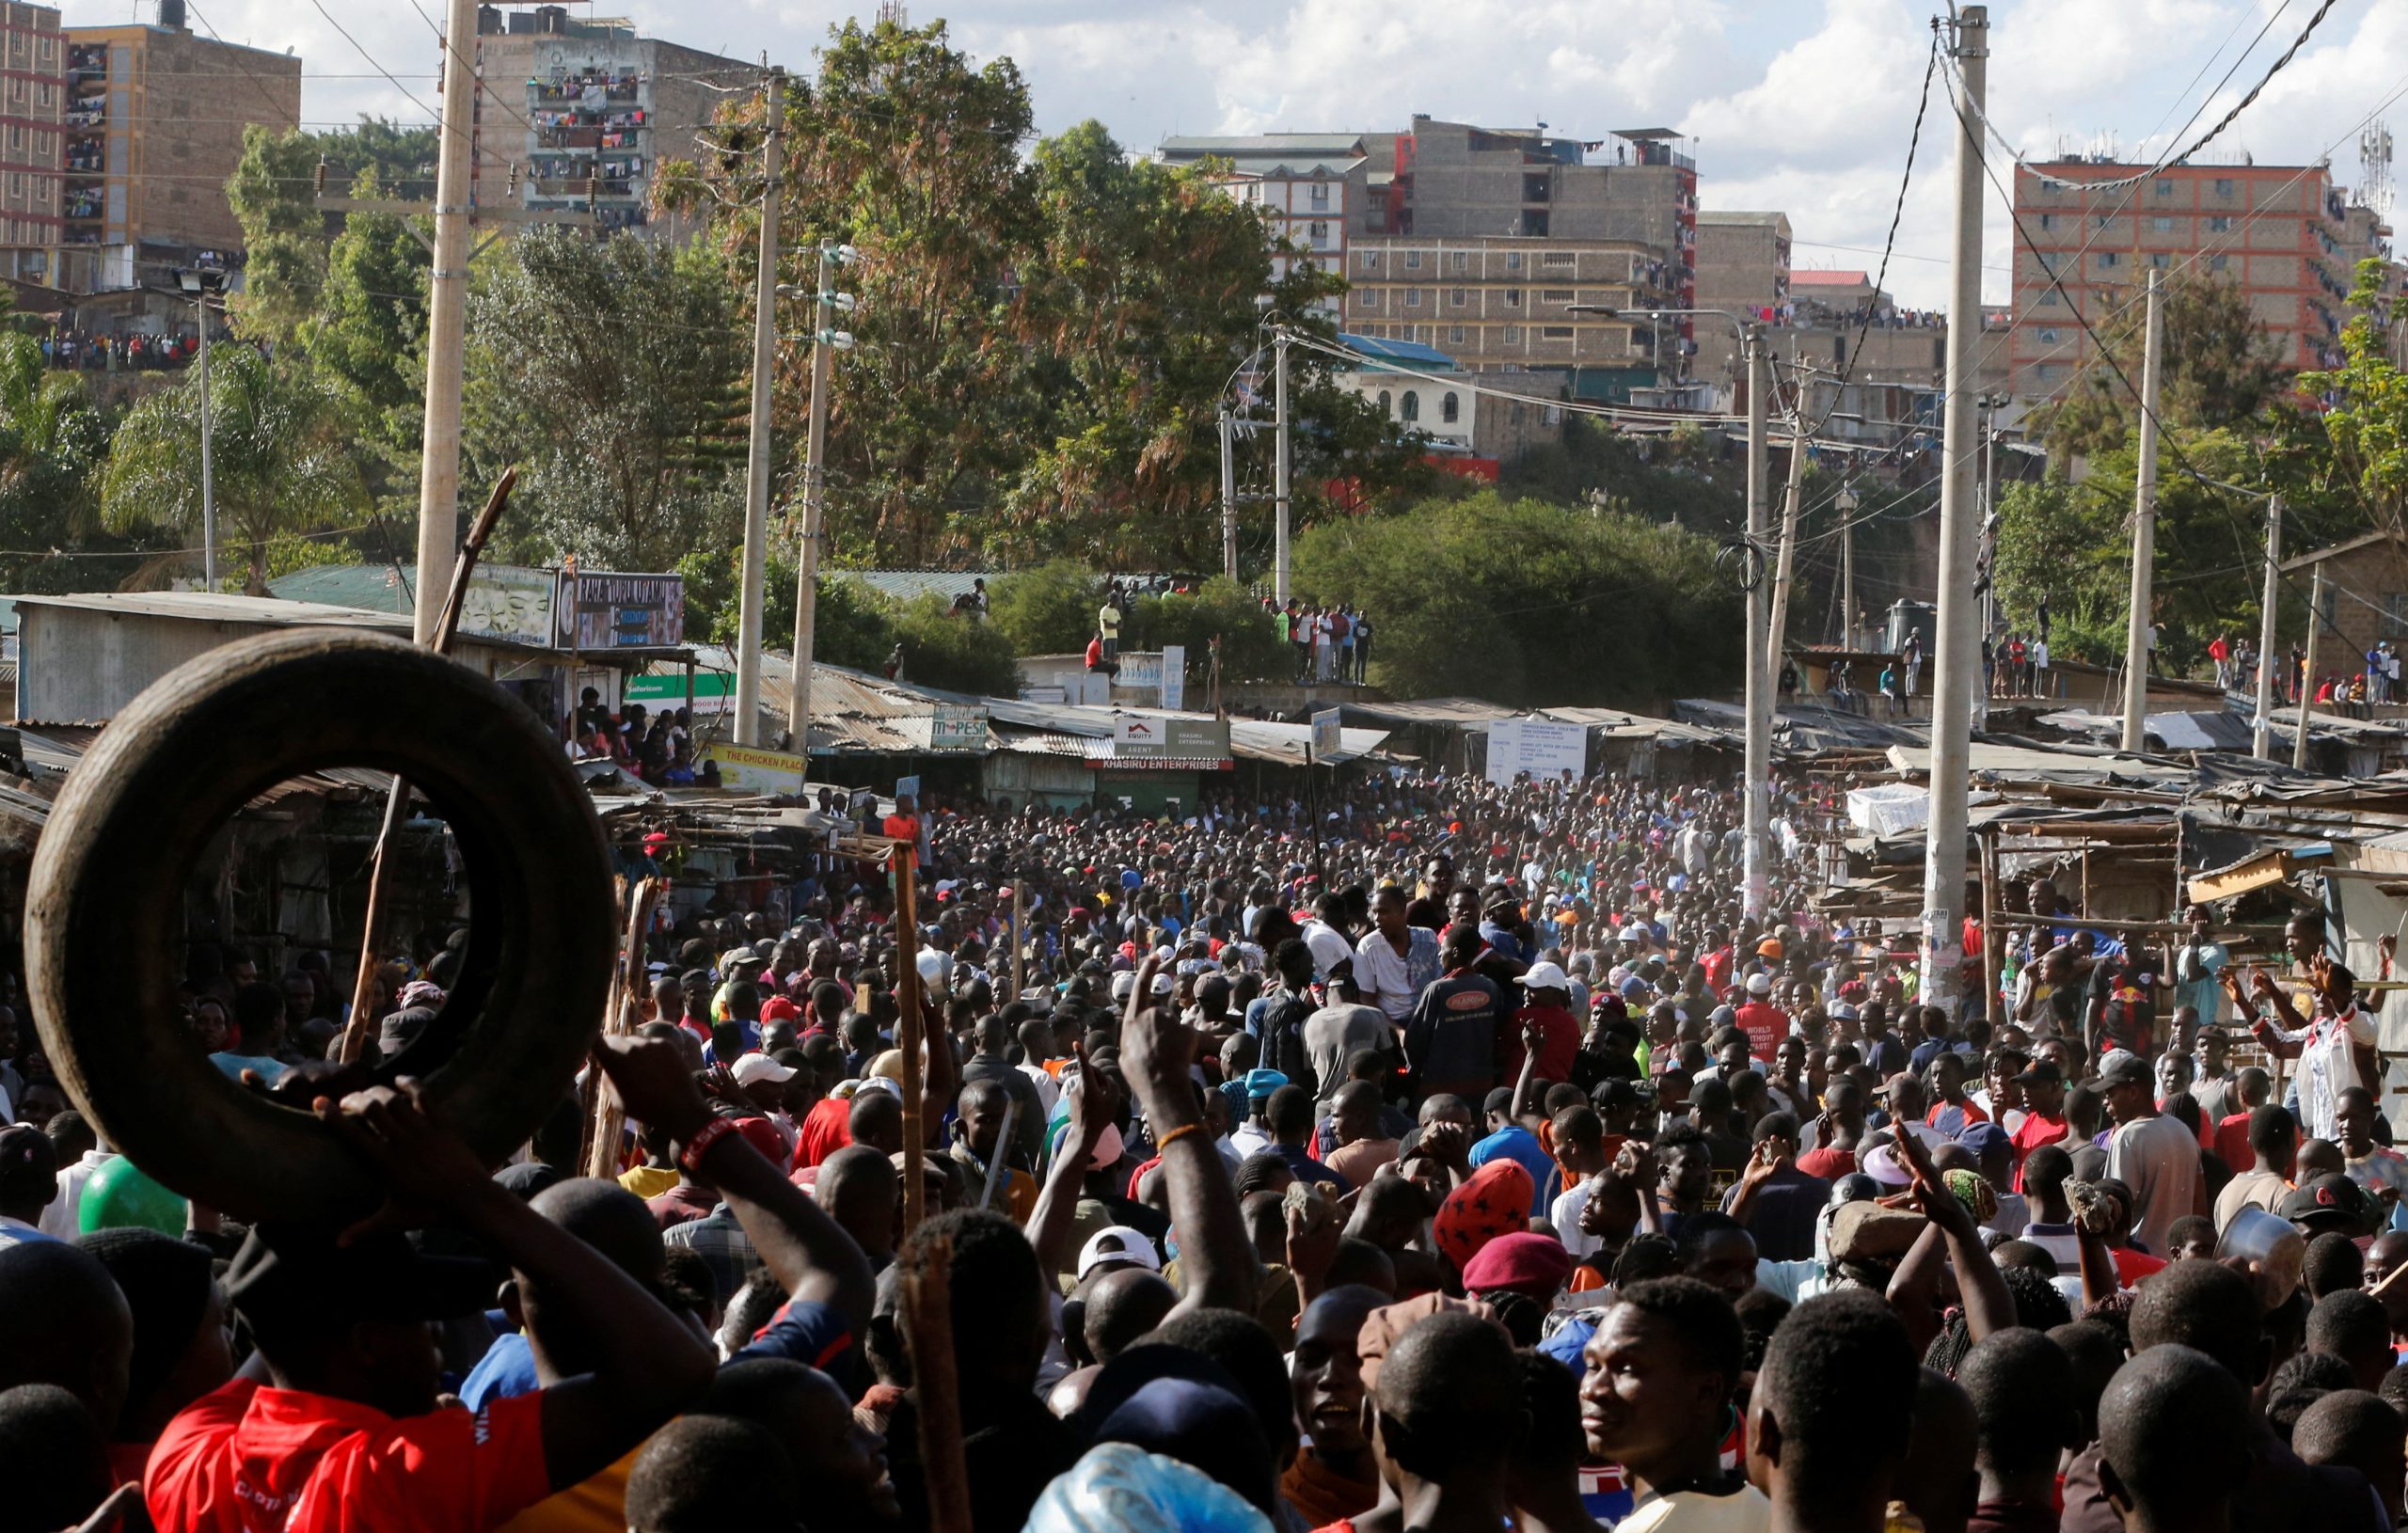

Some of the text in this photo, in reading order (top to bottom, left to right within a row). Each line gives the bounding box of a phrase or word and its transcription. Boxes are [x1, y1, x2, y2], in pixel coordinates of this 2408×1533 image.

[726, 751, 804, 771] THE CHICKEN PLACE
[1102, 760, 1219, 770] KHASIRU ENTERPRISES
[1746, 1026, 1771, 1035] WORLD
